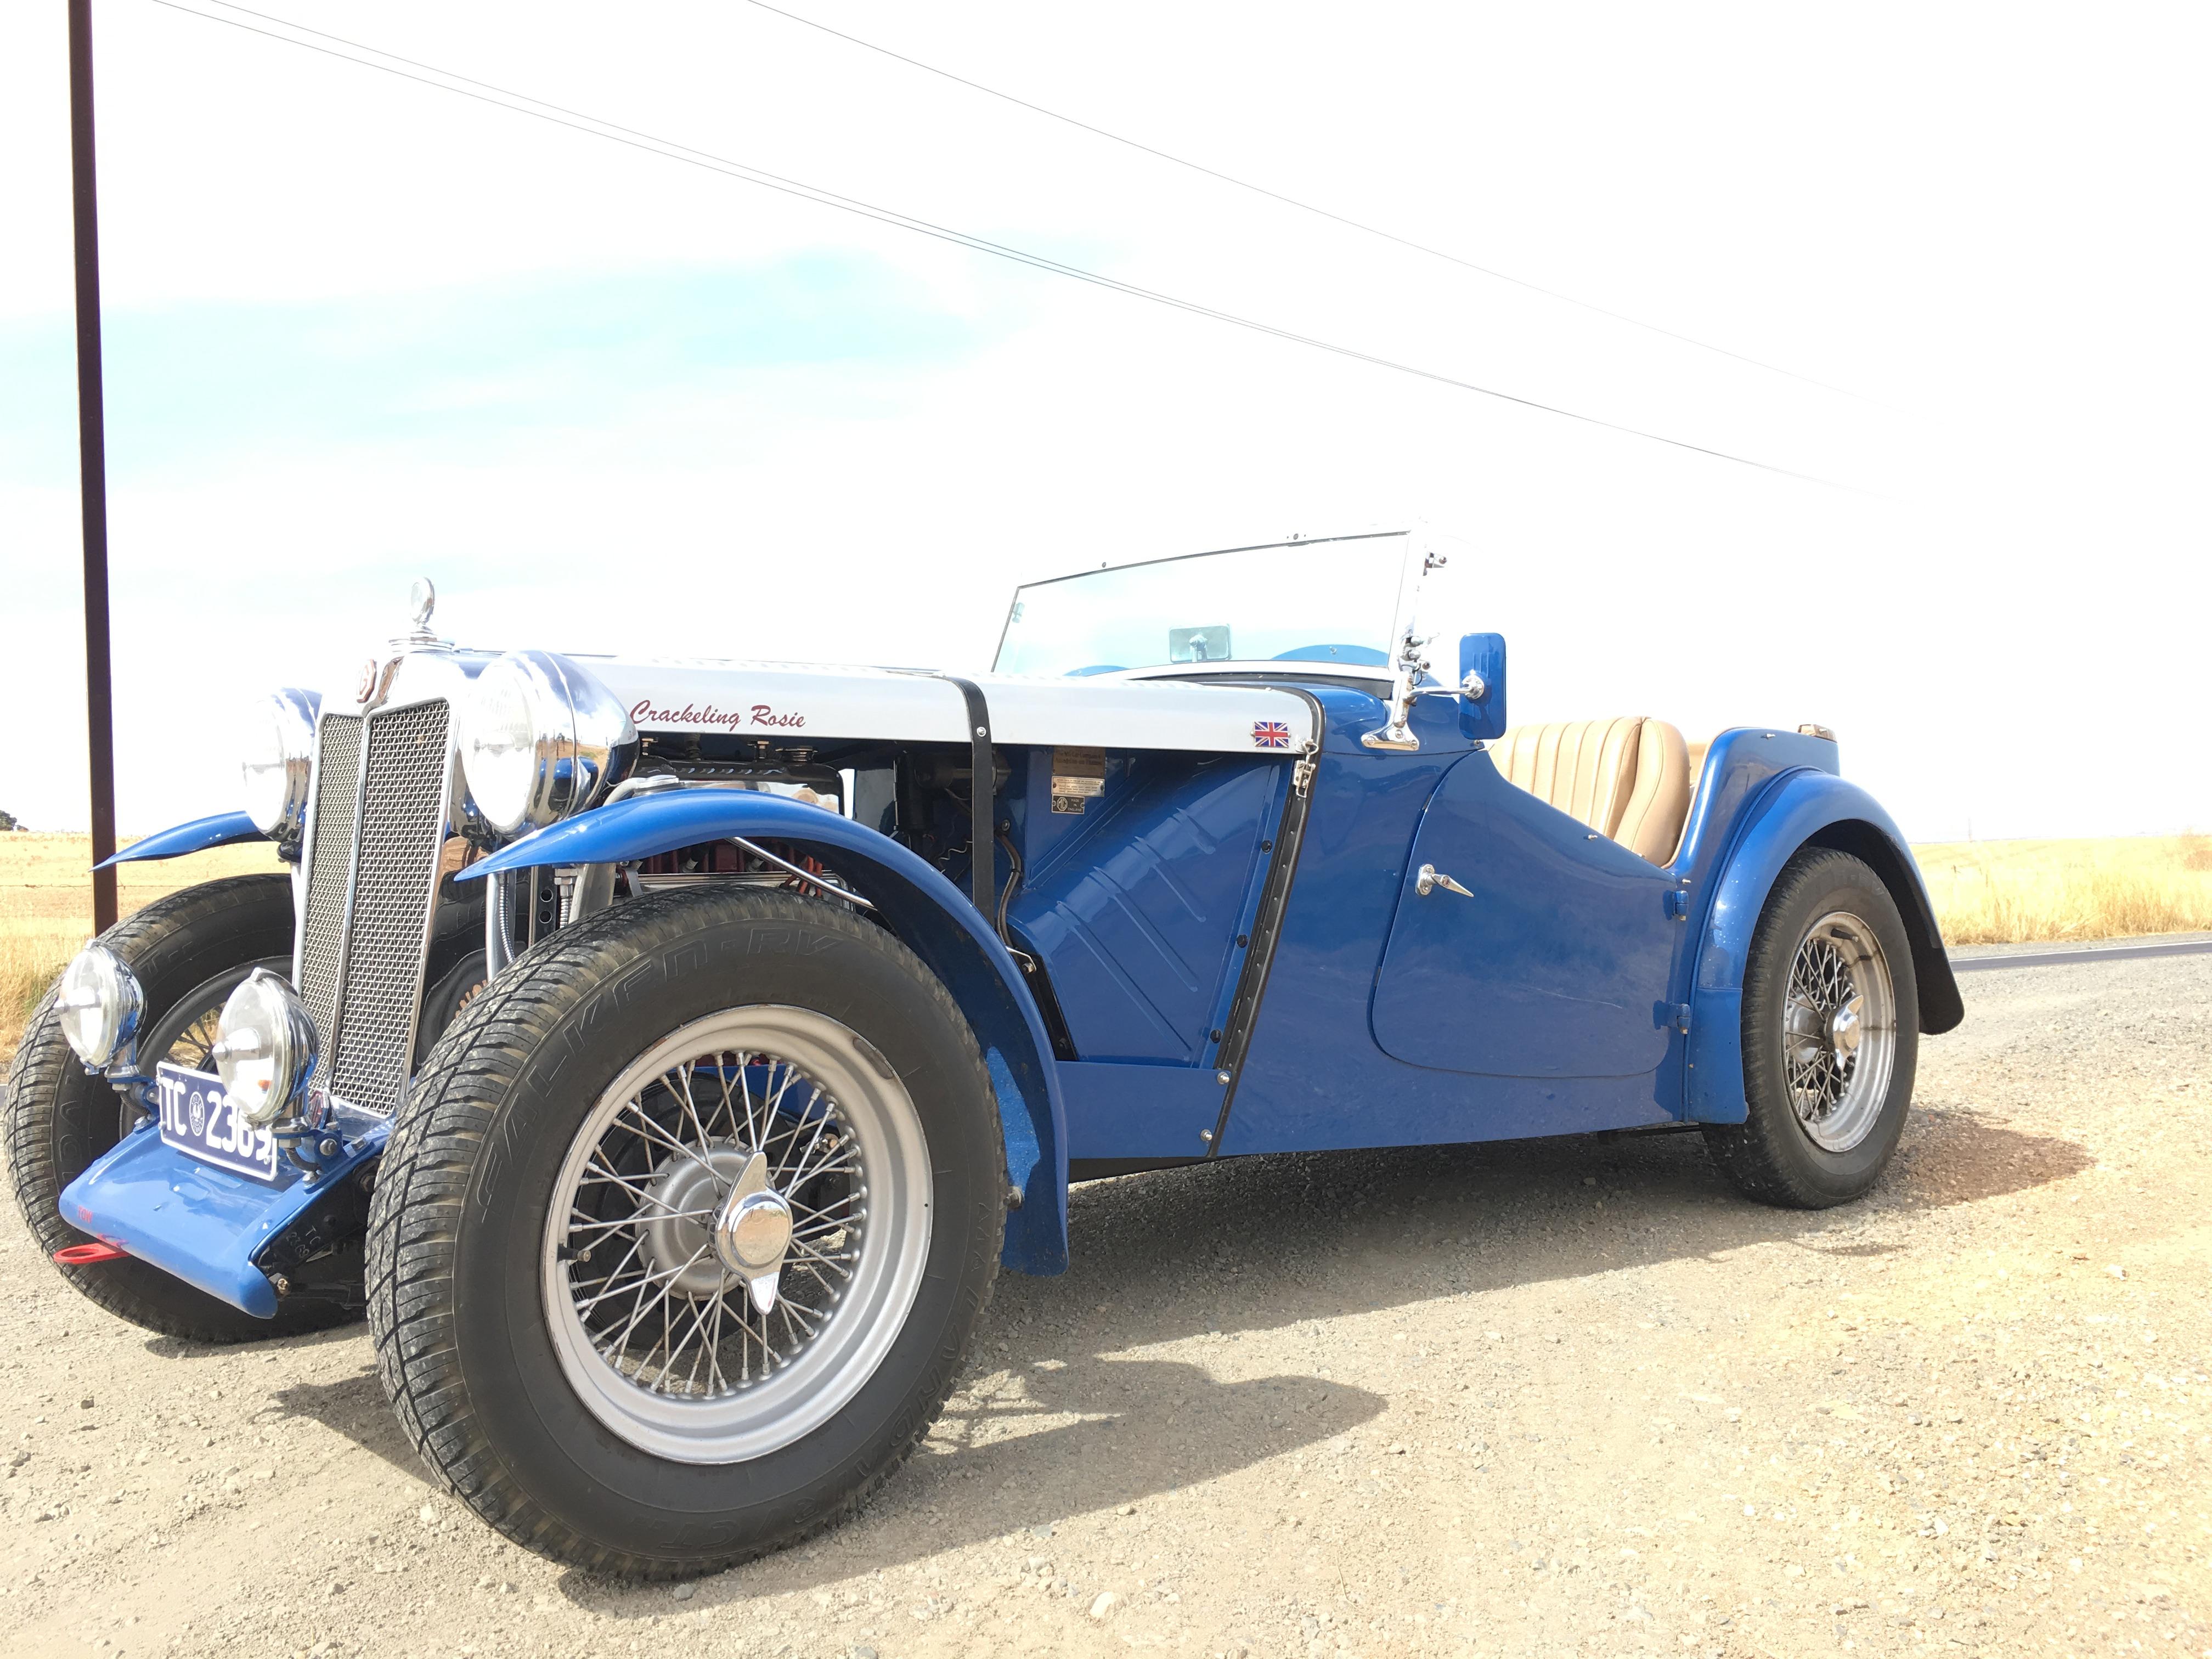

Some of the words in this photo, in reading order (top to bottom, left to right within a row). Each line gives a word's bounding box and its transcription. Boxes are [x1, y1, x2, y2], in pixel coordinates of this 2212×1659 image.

[630, 699, 741, 732] Crackeling
[750, 705, 806, 728] Rosie
[1058, 797, 1067, 810] MG
[161, 1076, 187, 1136] TC
[206, 1090, 273, 1161] 2369
[78, 1205, 93, 1224] TOW
